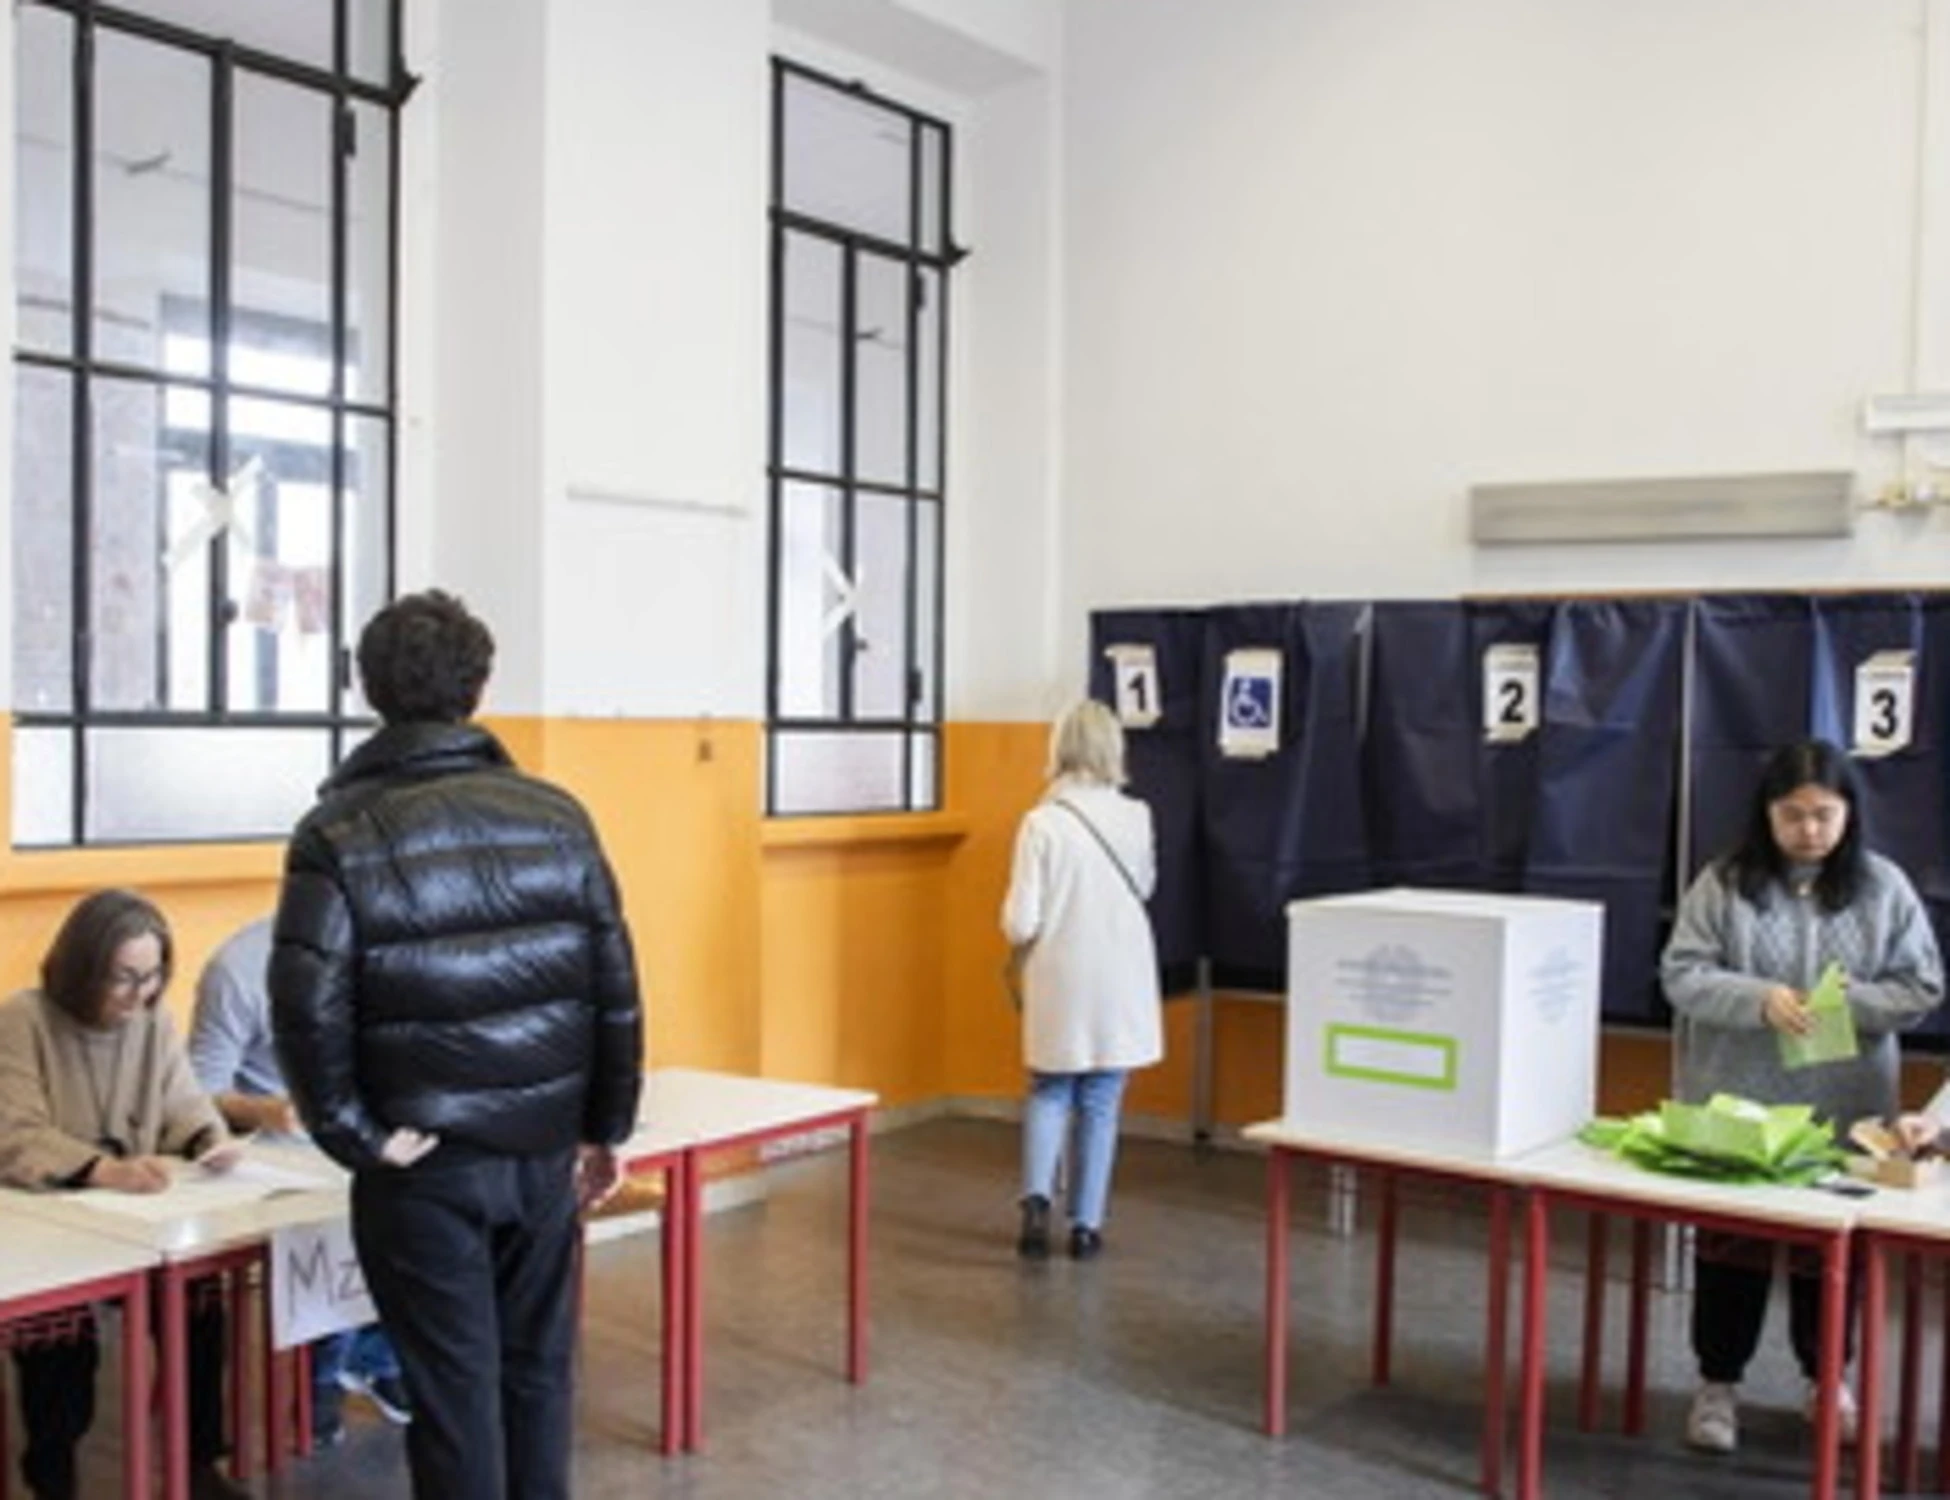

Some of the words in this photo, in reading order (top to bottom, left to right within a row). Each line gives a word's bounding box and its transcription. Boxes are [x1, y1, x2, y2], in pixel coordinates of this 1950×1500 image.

[1128, 671, 1145, 711] 1
[1500, 680, 1524, 723] 2
[1872, 688, 1897, 739] 3
